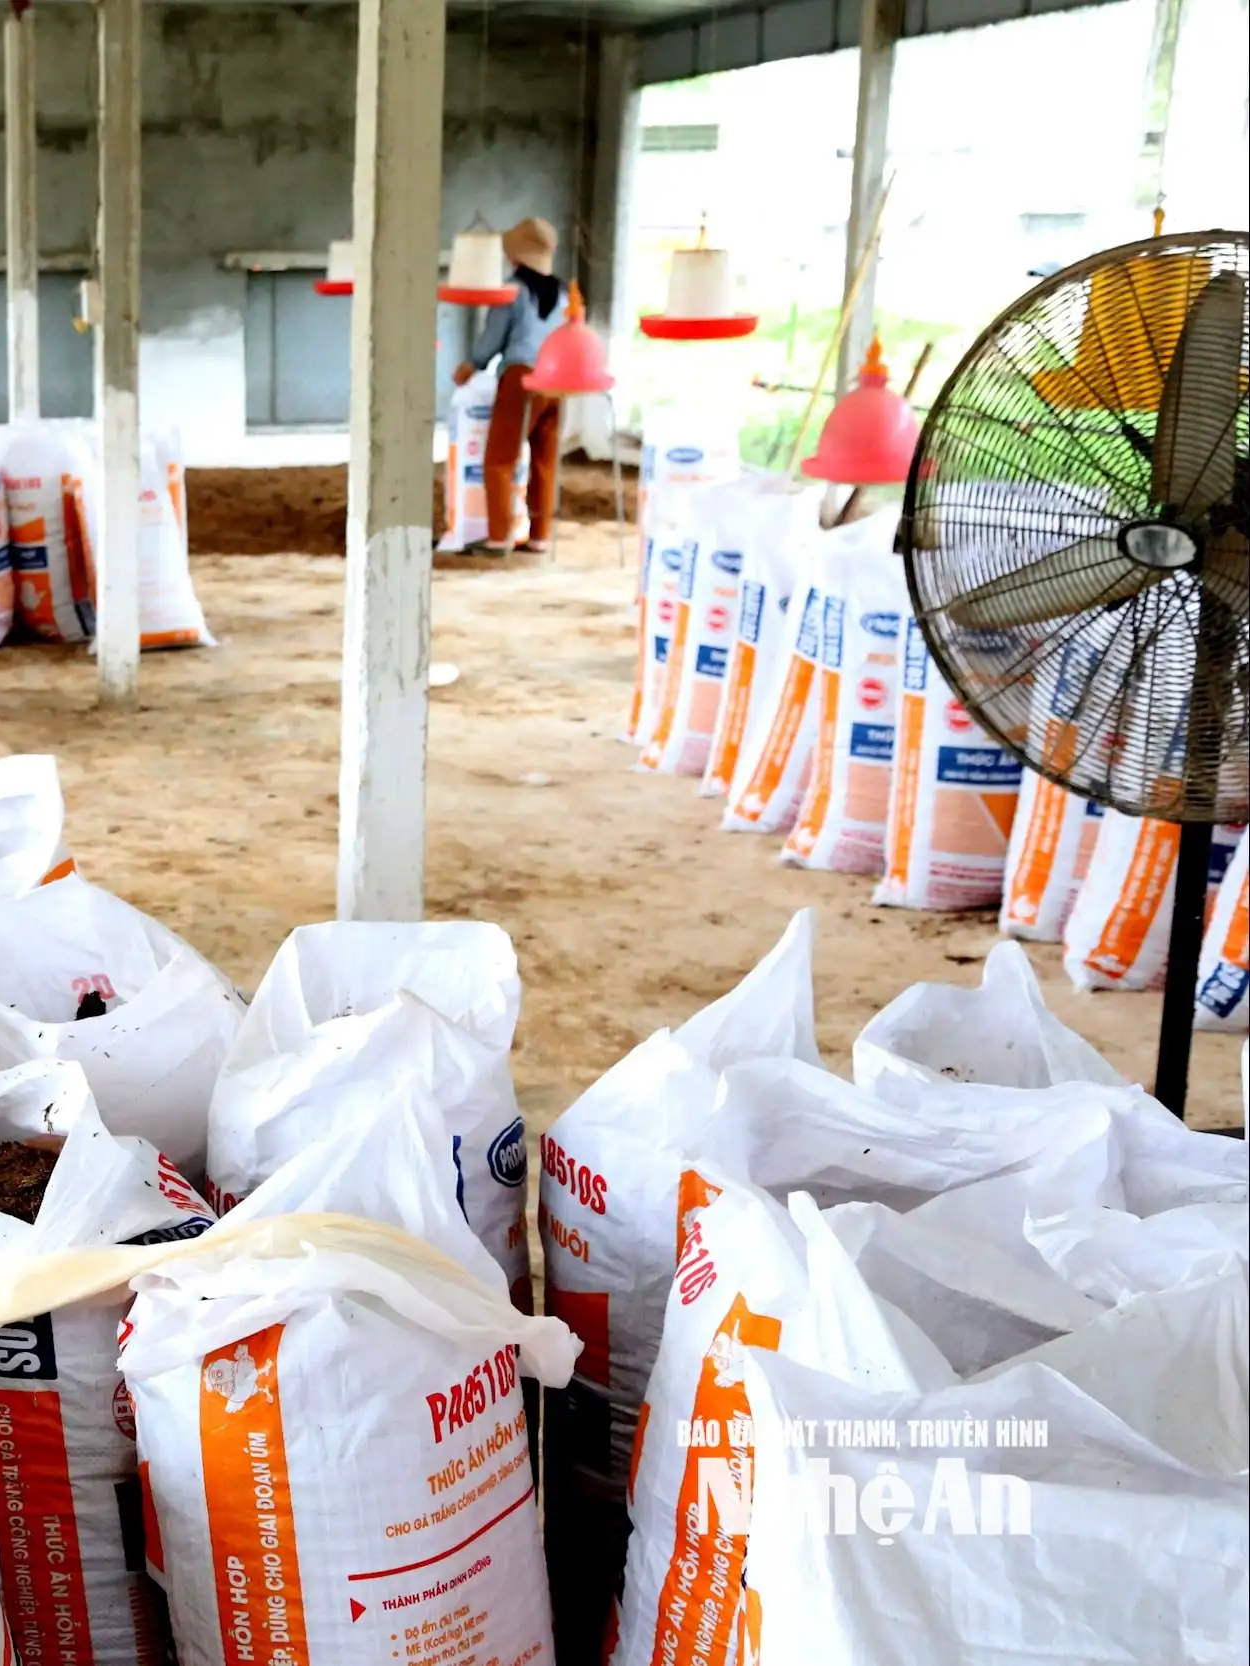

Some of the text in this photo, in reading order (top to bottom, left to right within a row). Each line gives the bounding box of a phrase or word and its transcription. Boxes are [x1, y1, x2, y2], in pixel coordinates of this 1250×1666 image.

[0, 1439, 23, 1461] GÀ
[243, 1432, 269, 1459] ÚM
[427, 1459, 466, 1495] THỨC
[469, 1445, 486, 1472] ĂN
[487, 1421, 513, 1457] HỖN
[2, 1463, 30, 1512] TRẮNG
[8, 1516, 31, 1560] CÔNG
[42, 1513, 66, 1565] THỨC
[258, 1513, 279, 1549] GIAI
[386, 1521, 411, 1538] CHO
[414, 1514, 430, 1532] GÀ
[430, 1502, 457, 1525] TRẮNG
[50, 1571, 72, 1599] ĂN
[262, 1553, 285, 1591] CHO
[676, 1545, 700, 1597] HỖN
[707, 1552, 731, 1599] DÙNG
[226, 1555, 254, 1660] HỖN HỢP
[382, 1593, 420, 1611] THÀNH
[423, 1580, 448, 1601] PHẦN
[665, 1594, 688, 1631] ĂN
[55, 1603, 82, 1646] HỖN
[262, 1595, 290, 1643] DÙNG
[405, 1626, 419, 1641] Độ
[406, 1642, 422, 1657] ME
